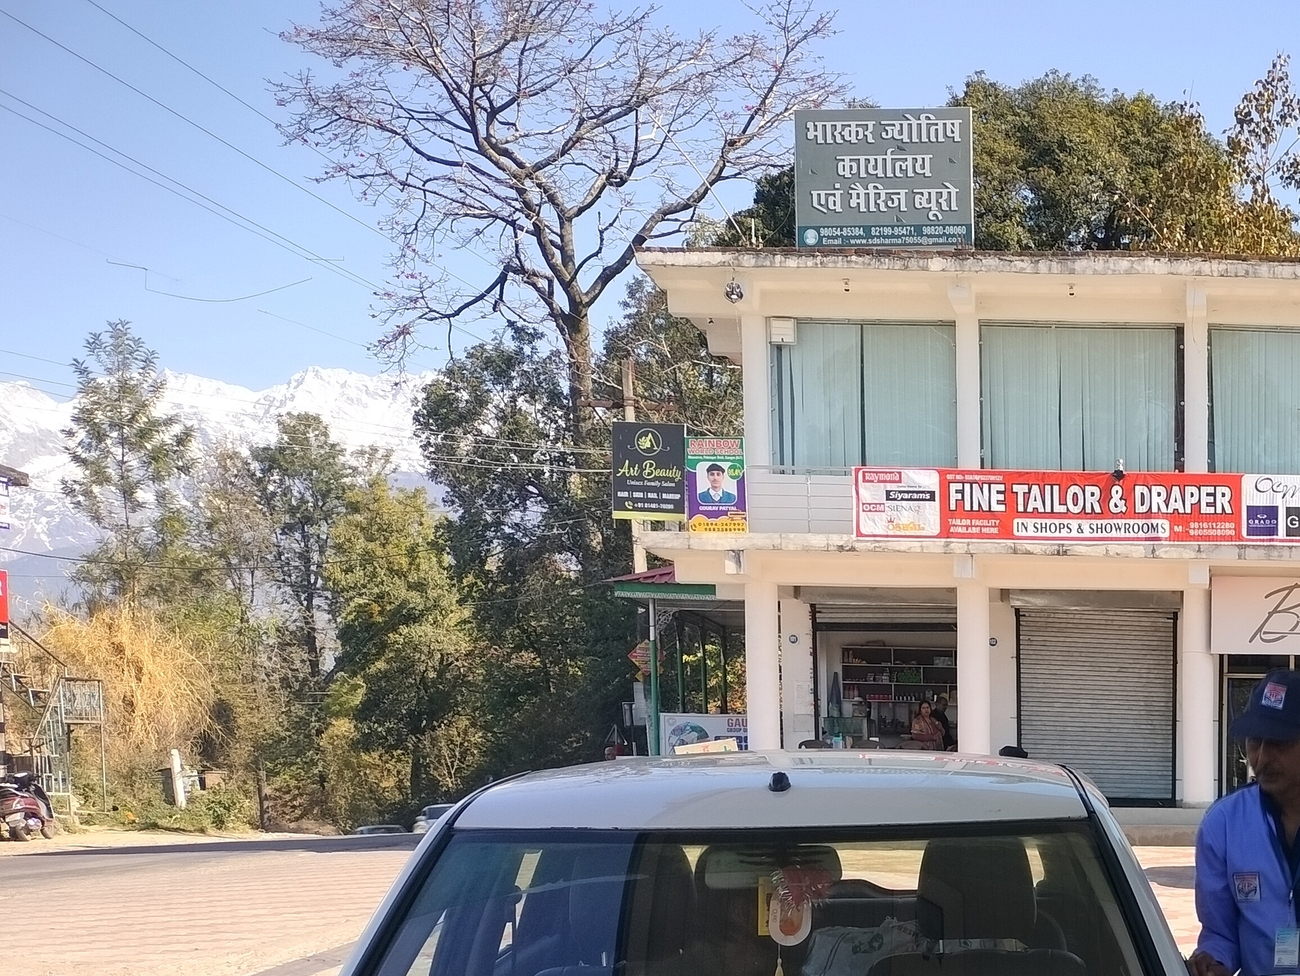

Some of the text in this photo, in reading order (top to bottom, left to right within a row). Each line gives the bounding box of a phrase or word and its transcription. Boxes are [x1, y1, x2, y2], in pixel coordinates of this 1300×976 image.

[806, 114, 962, 144] भास्कर ज्योतिष
[836, 148, 933, 178] कार्यालय
[811, 182, 959, 221] एवं मैरिज ब्यूरो
[822, 237, 842, 245] Email
[689, 439, 740, 449] RAINBOW
[616, 460, 682, 483] Art Beauty
[865, 472, 900, 482] Raymond
[949, 482, 1234, 515] FINE TAILOR & DRAPER
[863, 504, 885, 512] OCM
[972, 519, 1000, 527] FACILITY
[1016, 521, 1167, 534] IN SHOPS & SHOWROOMS
[1189, 521, 1235, 529] 9816112280
